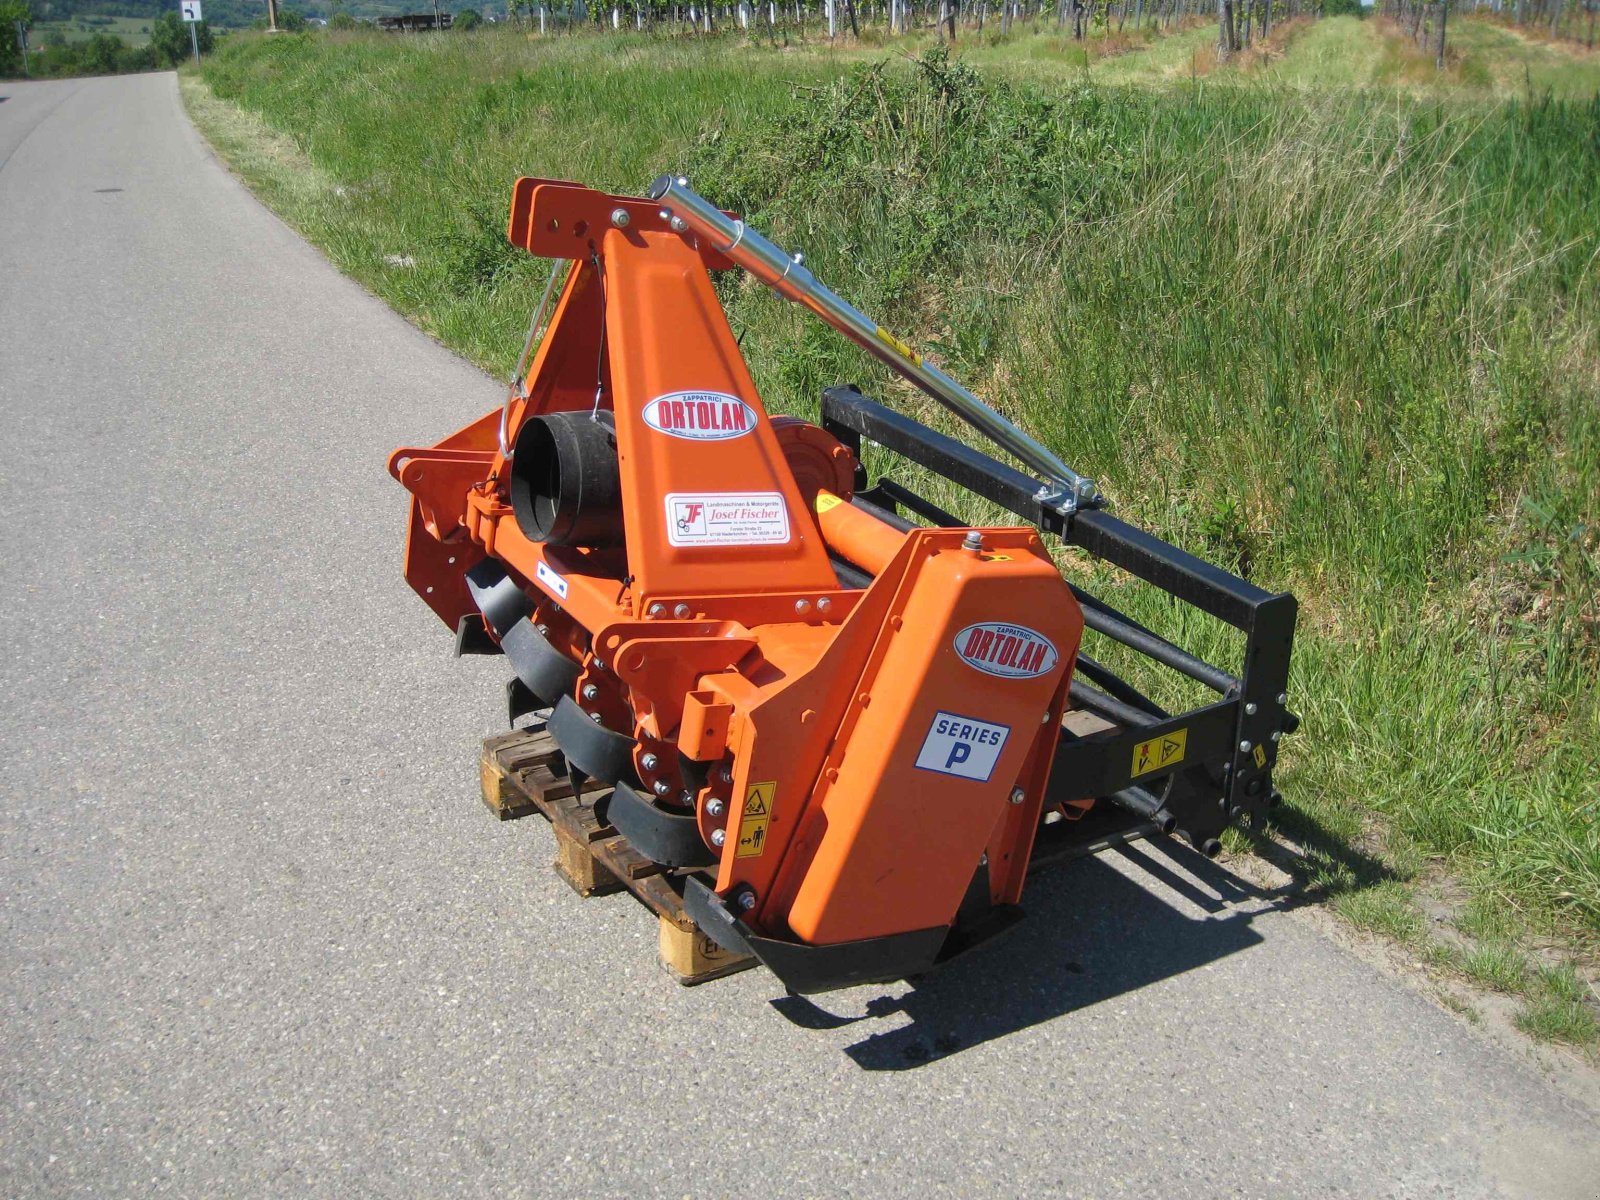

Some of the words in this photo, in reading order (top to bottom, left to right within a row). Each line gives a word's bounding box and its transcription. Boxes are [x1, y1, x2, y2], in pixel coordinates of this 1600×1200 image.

[658, 401, 746, 430] ORTOLAN
[709, 508, 740, 521] Josef
[741, 508, 779, 519] Fischer
[996, 626, 1033, 641] ZAPPATRICI
[963, 627, 1048, 672] ORTOLAN
[936, 719, 1001, 746] SERIES
[944, 741, 971, 769] P
